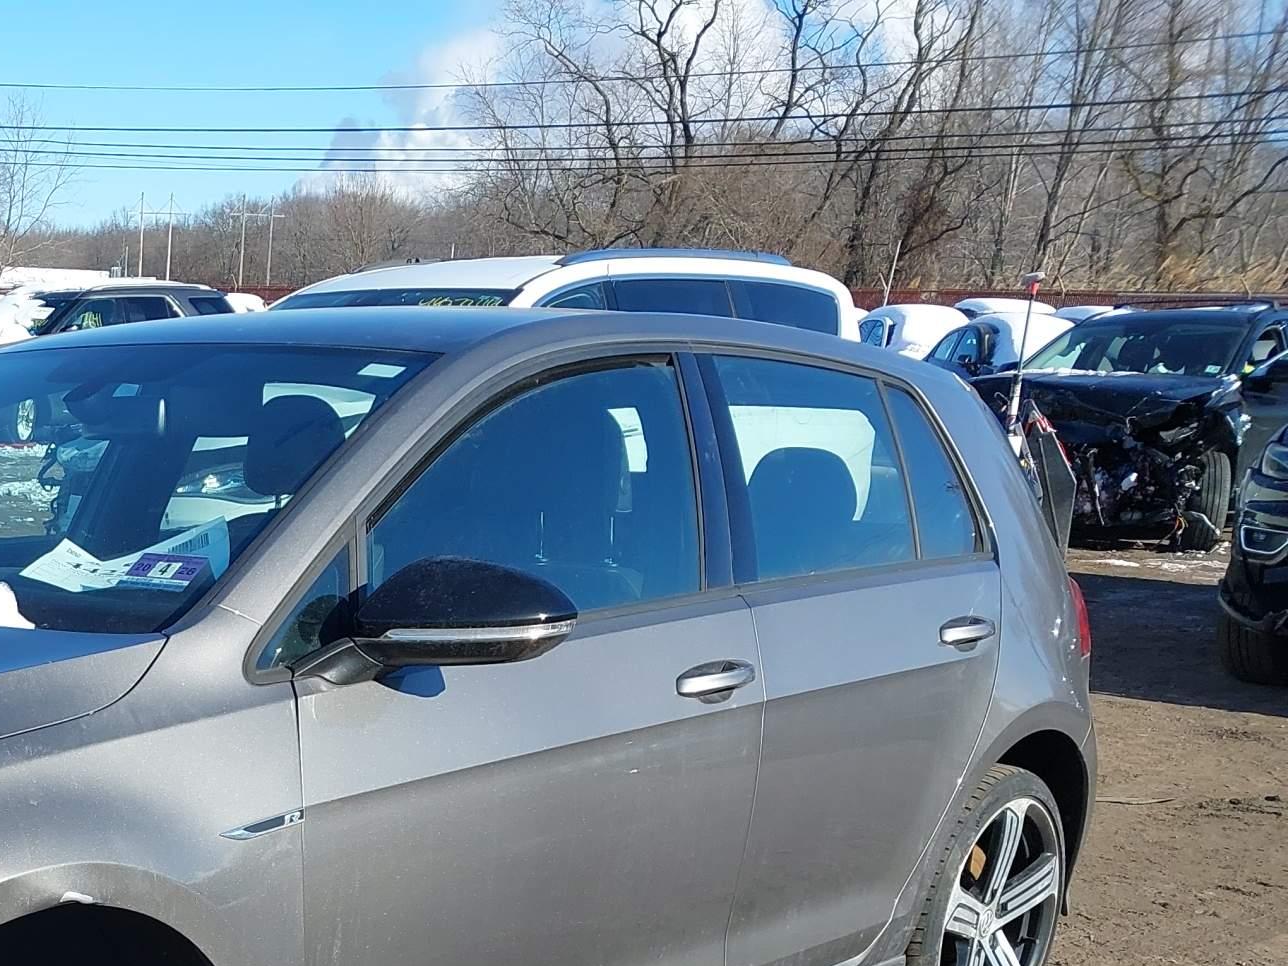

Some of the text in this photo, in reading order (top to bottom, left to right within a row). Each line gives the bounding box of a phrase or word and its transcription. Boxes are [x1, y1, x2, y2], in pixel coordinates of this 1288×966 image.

[134, 562, 152, 572] 20
[158, 562, 173, 576] 4
[284, 811, 301, 826] R
